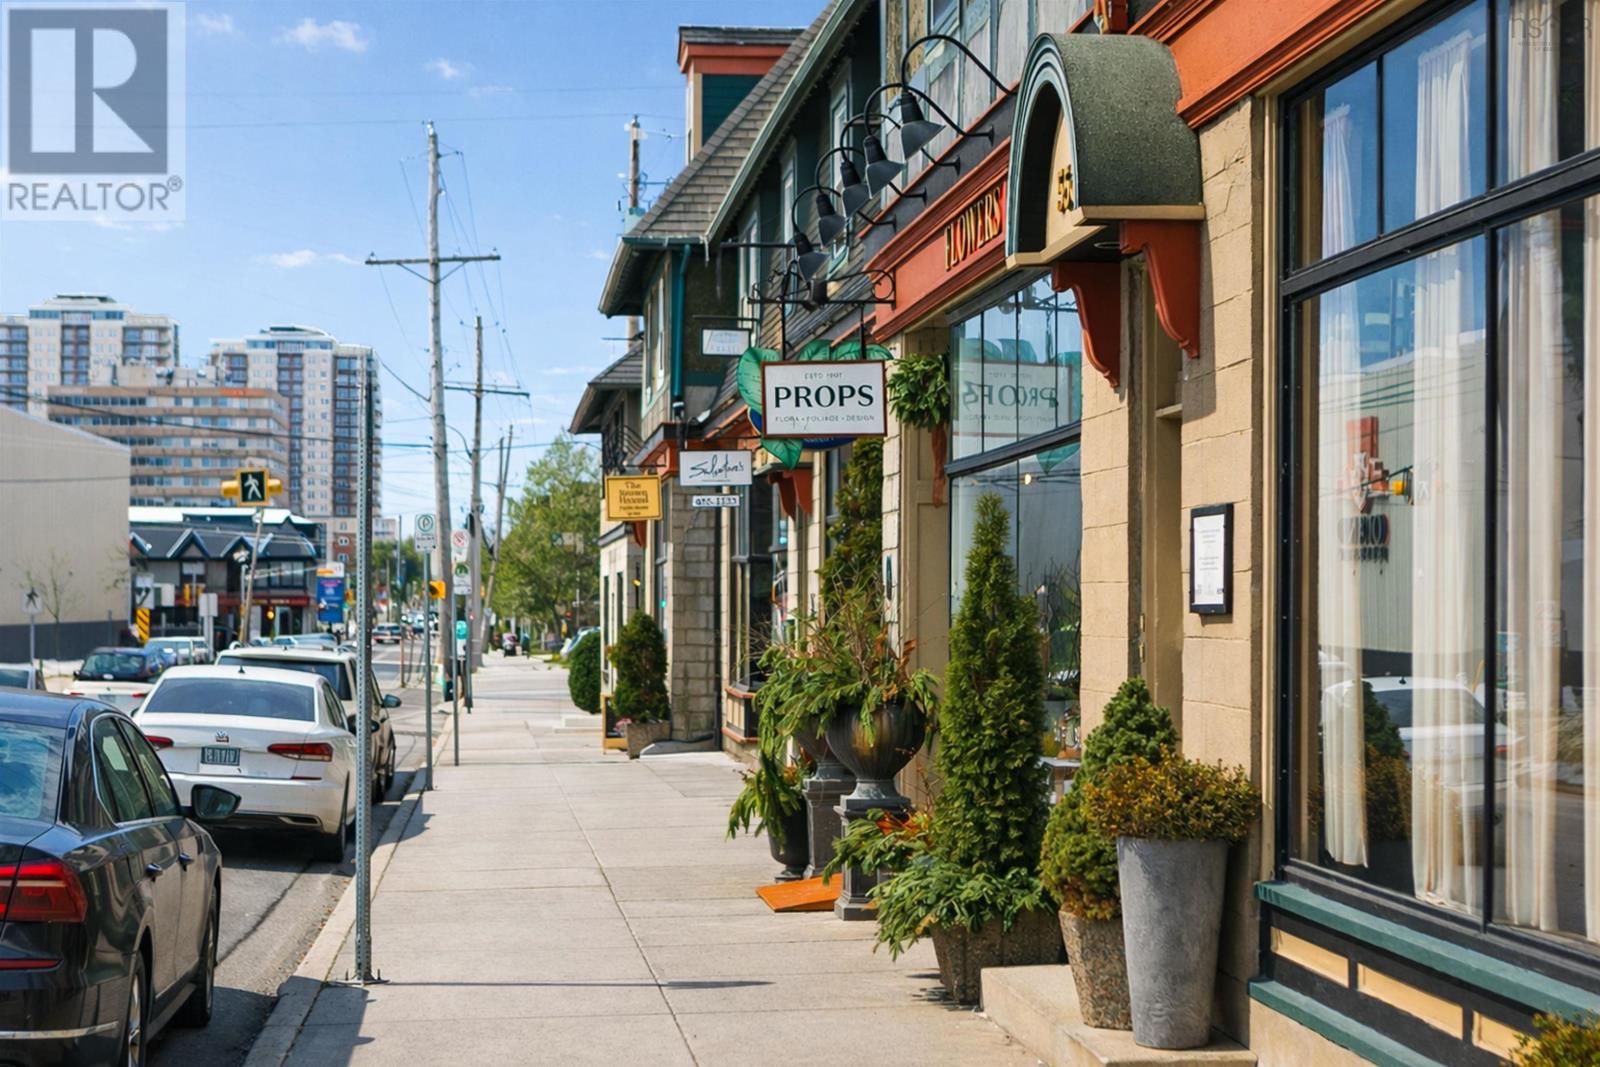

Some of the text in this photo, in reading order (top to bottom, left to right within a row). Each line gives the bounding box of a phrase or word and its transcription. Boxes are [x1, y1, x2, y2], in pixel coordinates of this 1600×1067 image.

[944, 186, 1002, 272] FLOWERS
[774, 384, 874, 408] PROPS
[845, 414, 875, 422] DESIGN
